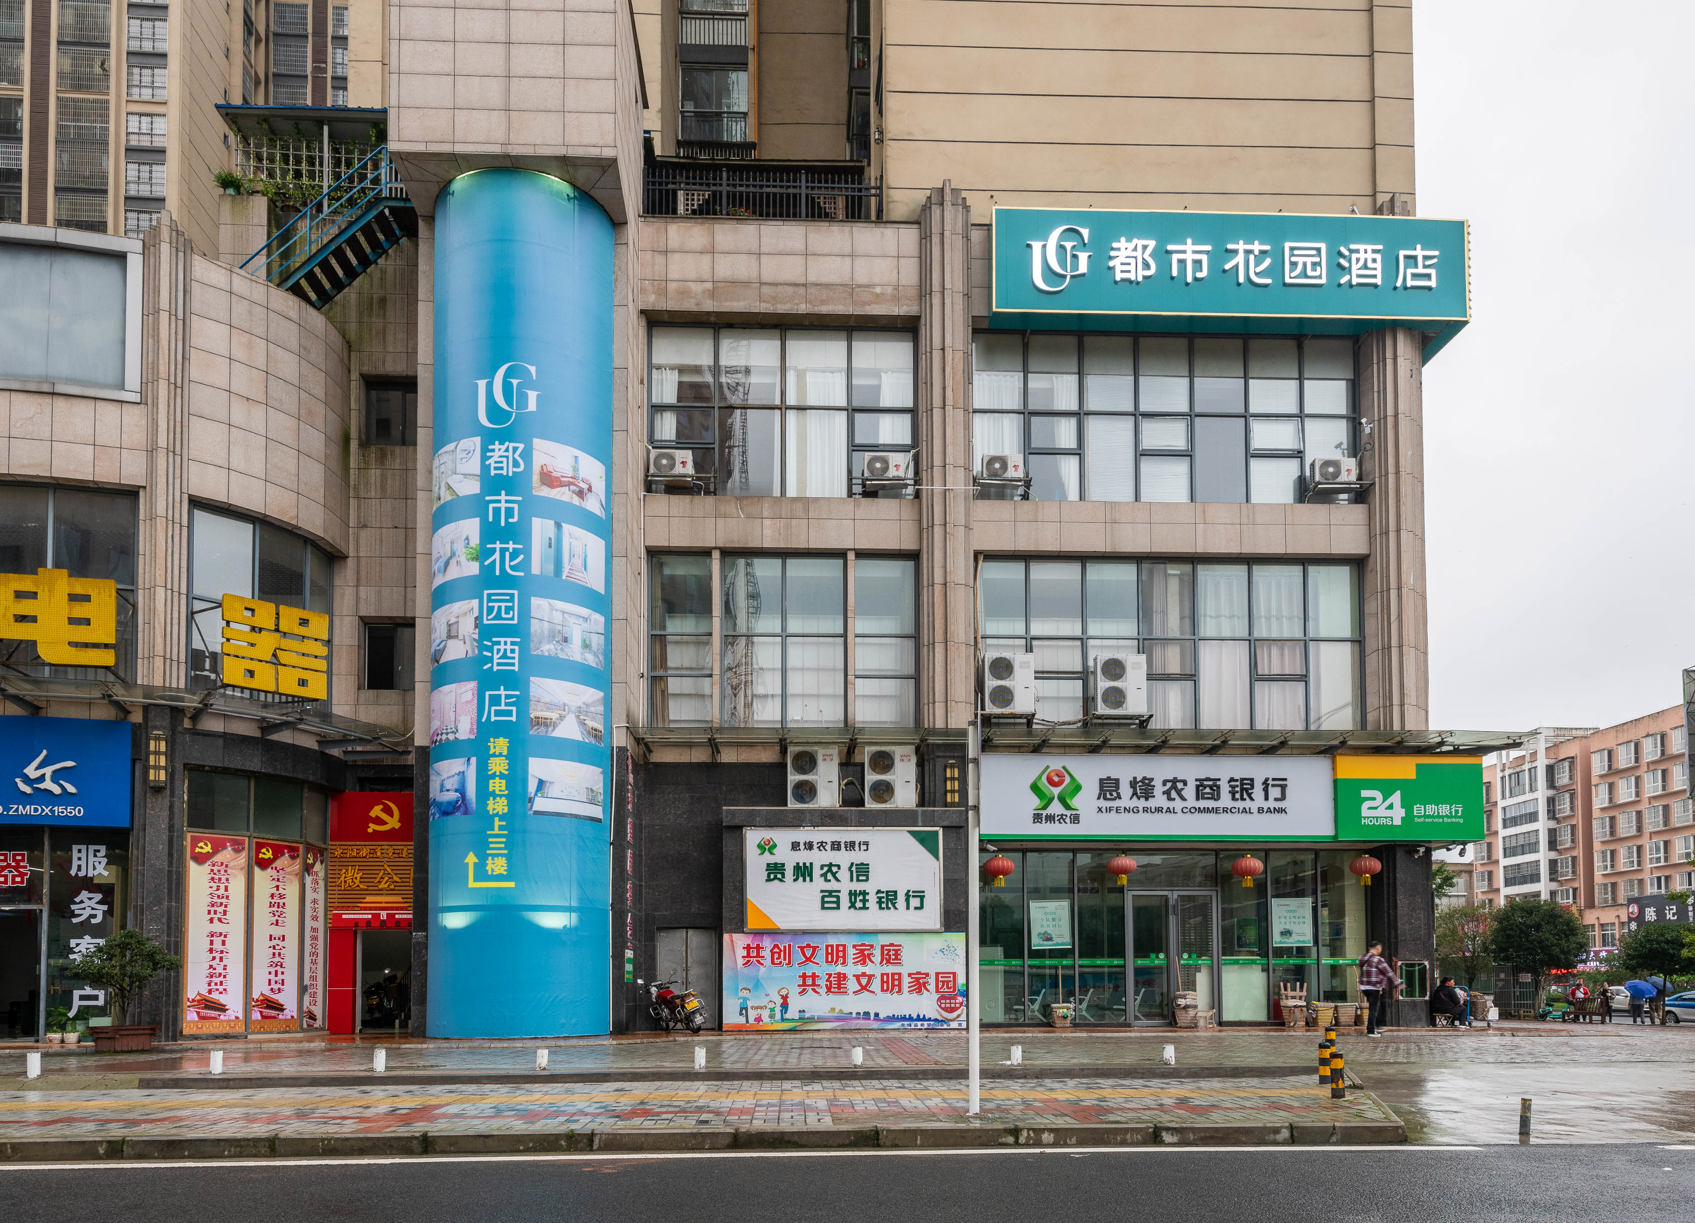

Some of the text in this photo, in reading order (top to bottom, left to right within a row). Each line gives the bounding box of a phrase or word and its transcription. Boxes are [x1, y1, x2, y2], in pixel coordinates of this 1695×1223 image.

[1108, 236, 1441, 289] 都市花园酒店
[481, 441, 525, 723] 都市花园酒店
[1097, 776, 1289, 802] 息烽农商银行
[485, 737, 510, 876] 请乘电梯上三楼
[1096, 806, 1288, 815] XIFENG RURAL COMMERCIAL BANK
[1360, 789, 1406, 826] 24
[1413, 804, 1464, 817] 自助银行
[1032, 812, 1081, 825] 贵州农信
[1361, 817, 1393, 826] HOURS
[790, 840, 870, 852] 息烽农商银行
[336, 863, 413, 891] 微公
[765, 861, 871, 883] 贵州农信
[820, 889, 926, 911] 百姓银行
[1645, 905, 1677, 922] 陈记
[741, 942, 904, 968] 共创文明家庭
[796, 971, 959, 996] 共建文明家园
